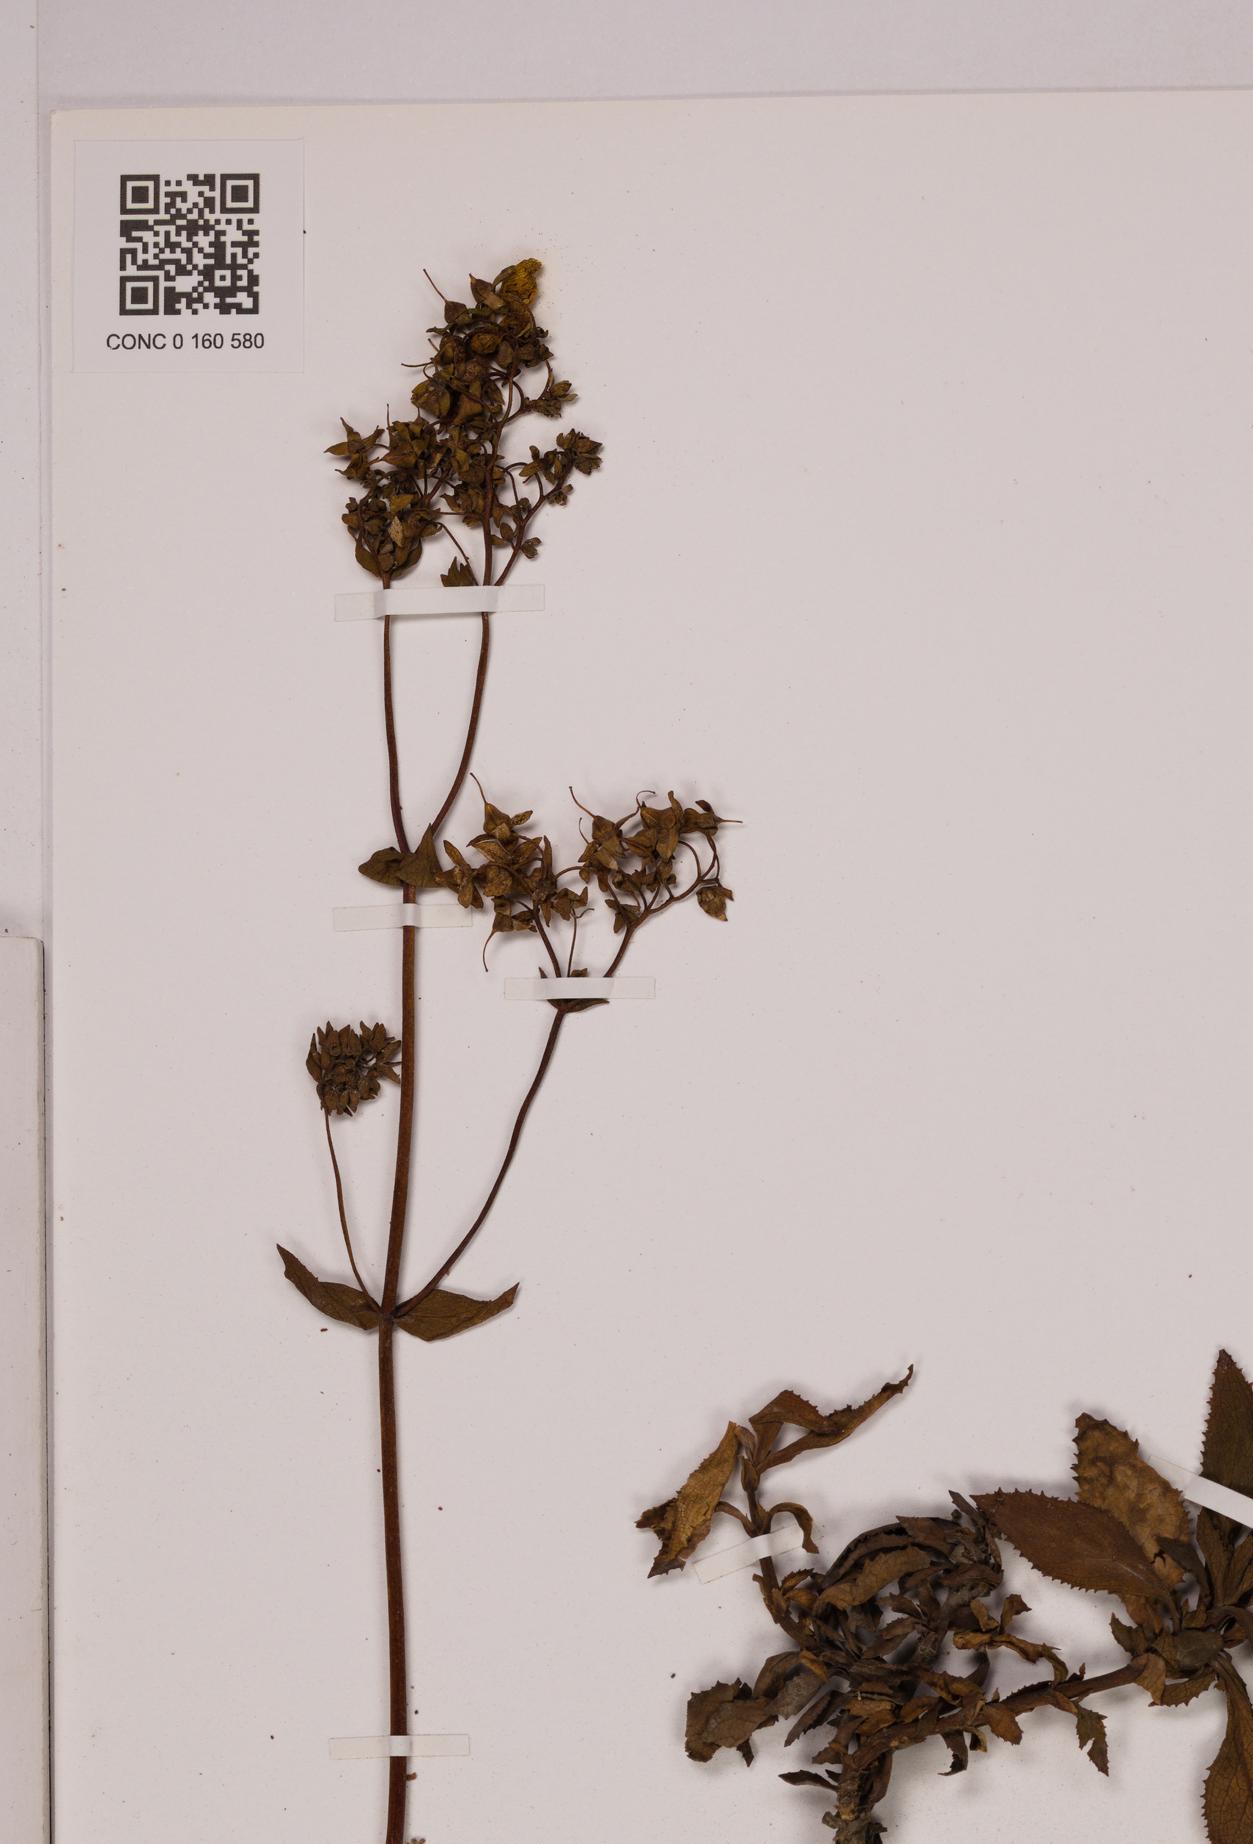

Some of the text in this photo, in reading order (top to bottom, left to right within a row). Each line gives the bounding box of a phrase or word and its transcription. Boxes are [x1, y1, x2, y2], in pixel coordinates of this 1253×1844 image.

[106, 332, 265, 351] CONC 0 160 580
